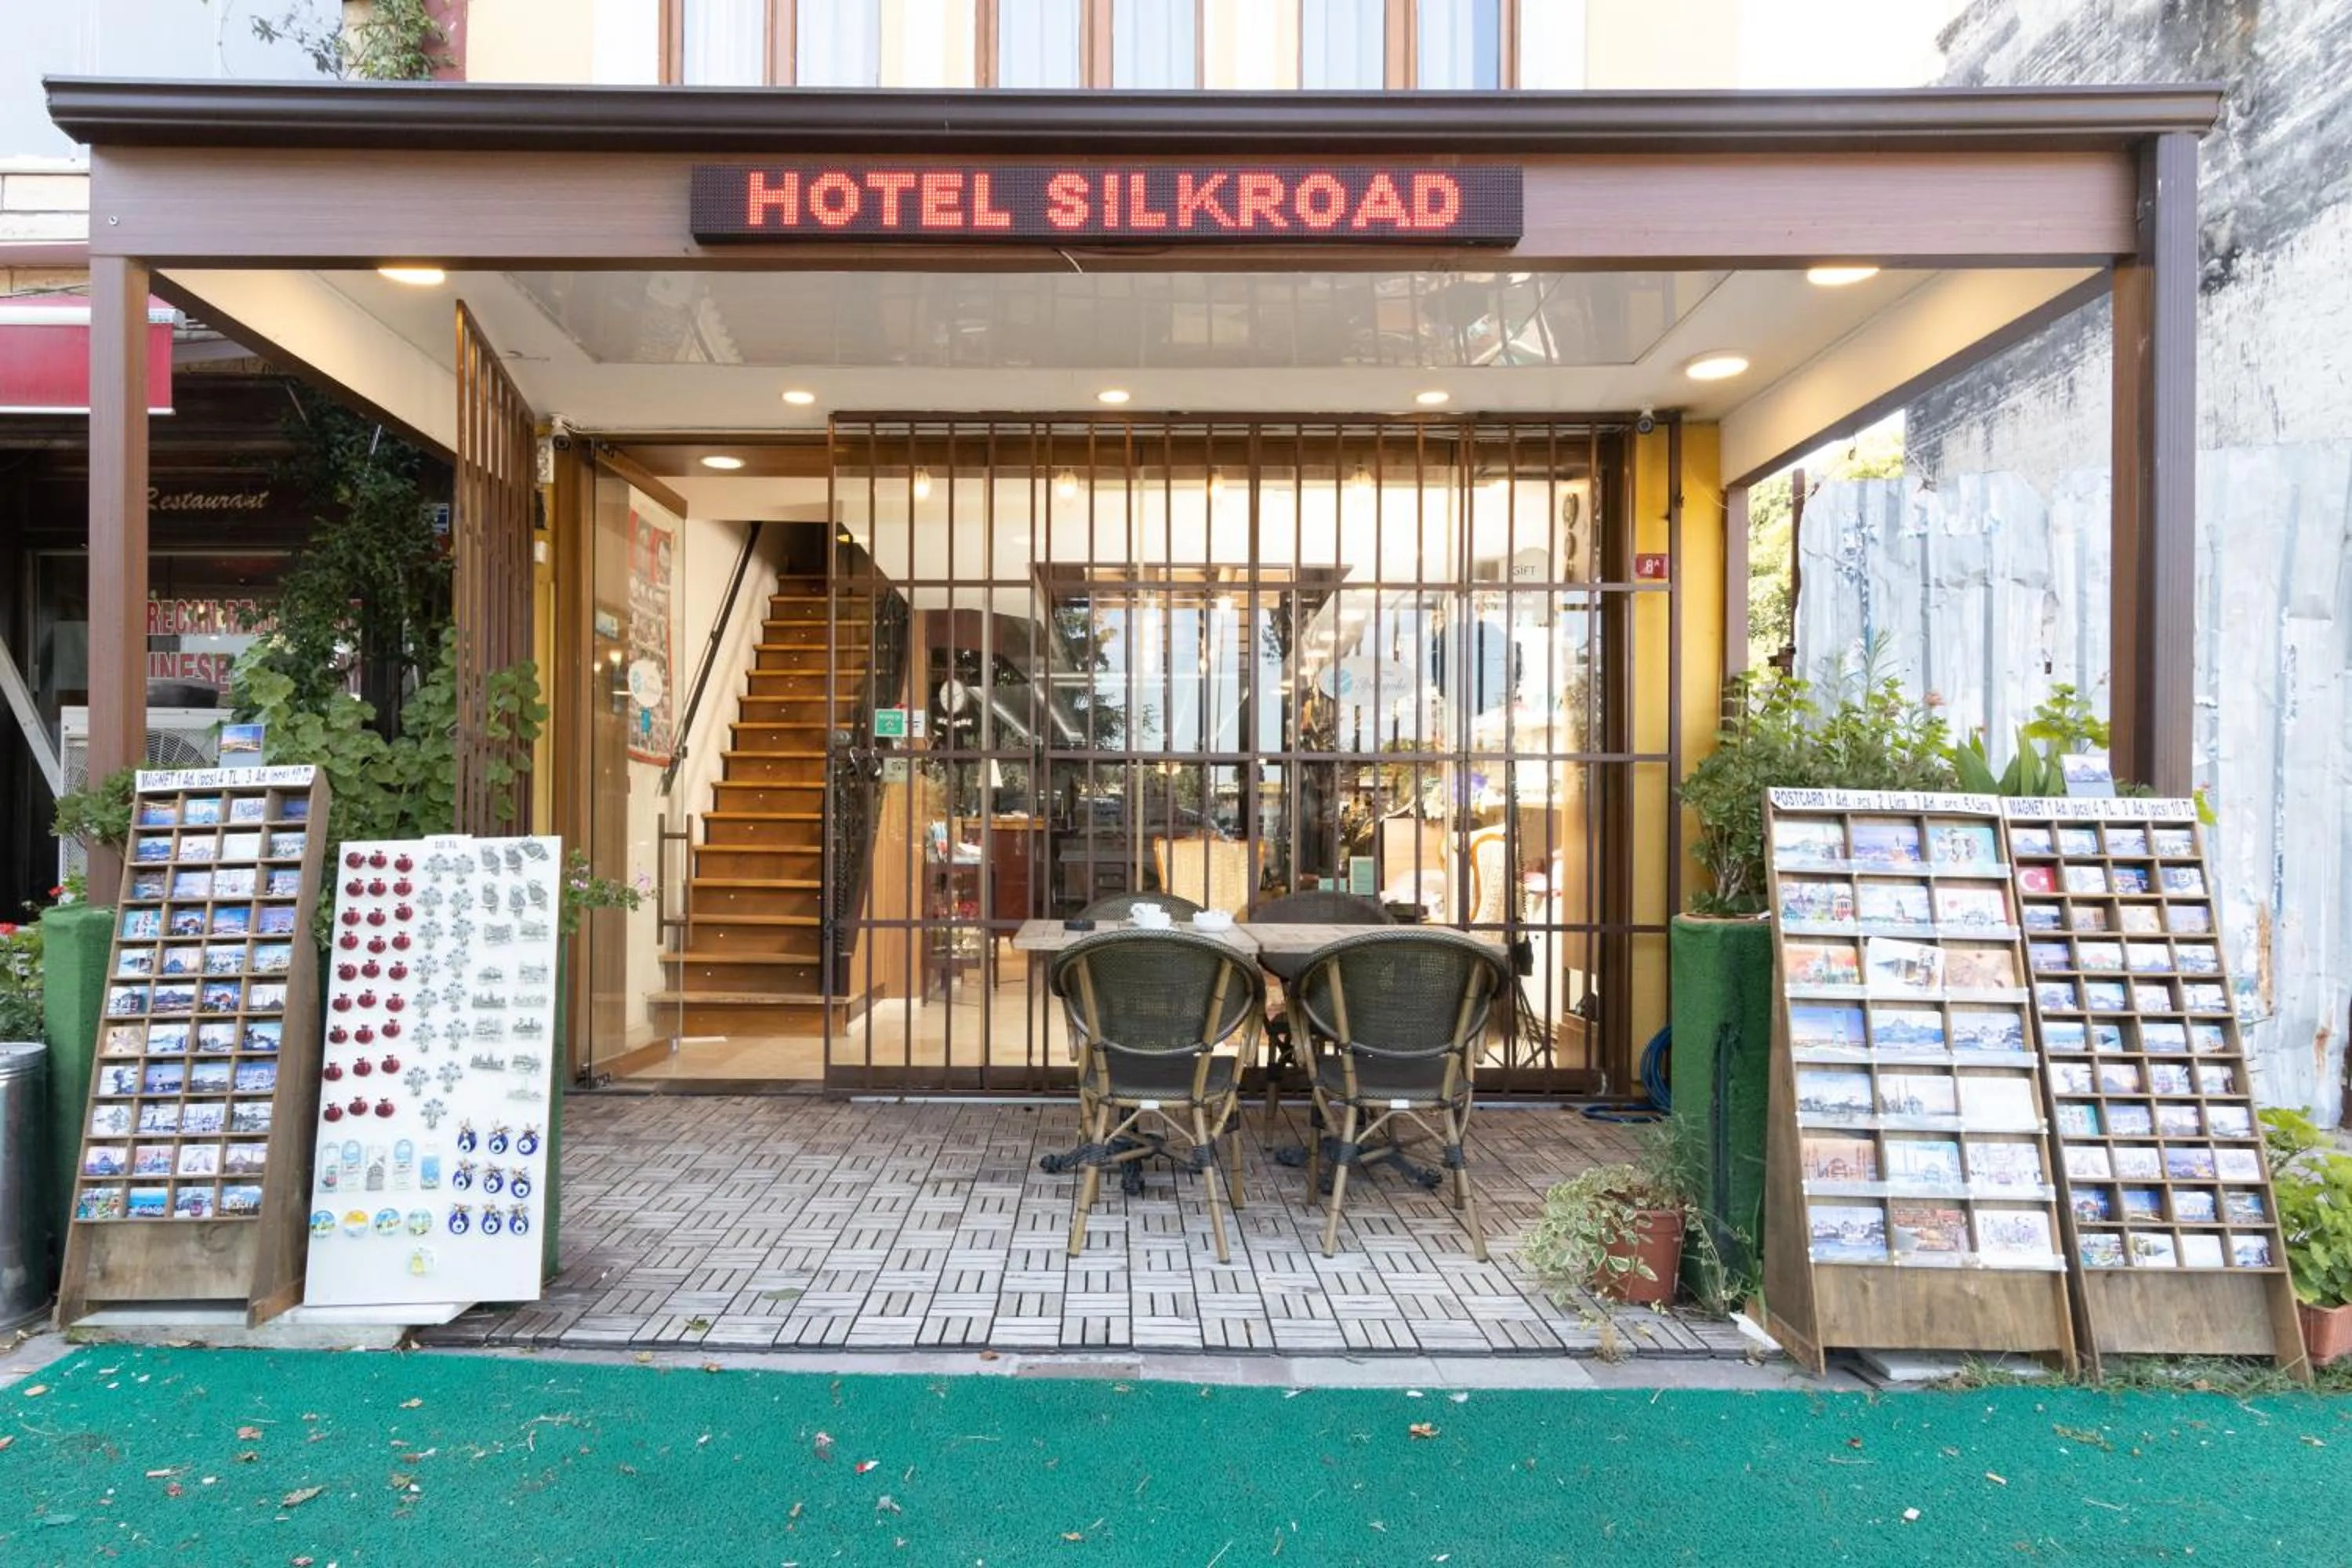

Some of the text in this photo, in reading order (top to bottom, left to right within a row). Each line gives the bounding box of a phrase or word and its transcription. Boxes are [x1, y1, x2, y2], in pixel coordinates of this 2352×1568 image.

[746, 170, 1462, 229] HOTEL SILKROAD
[147, 652, 231, 695] INESE
